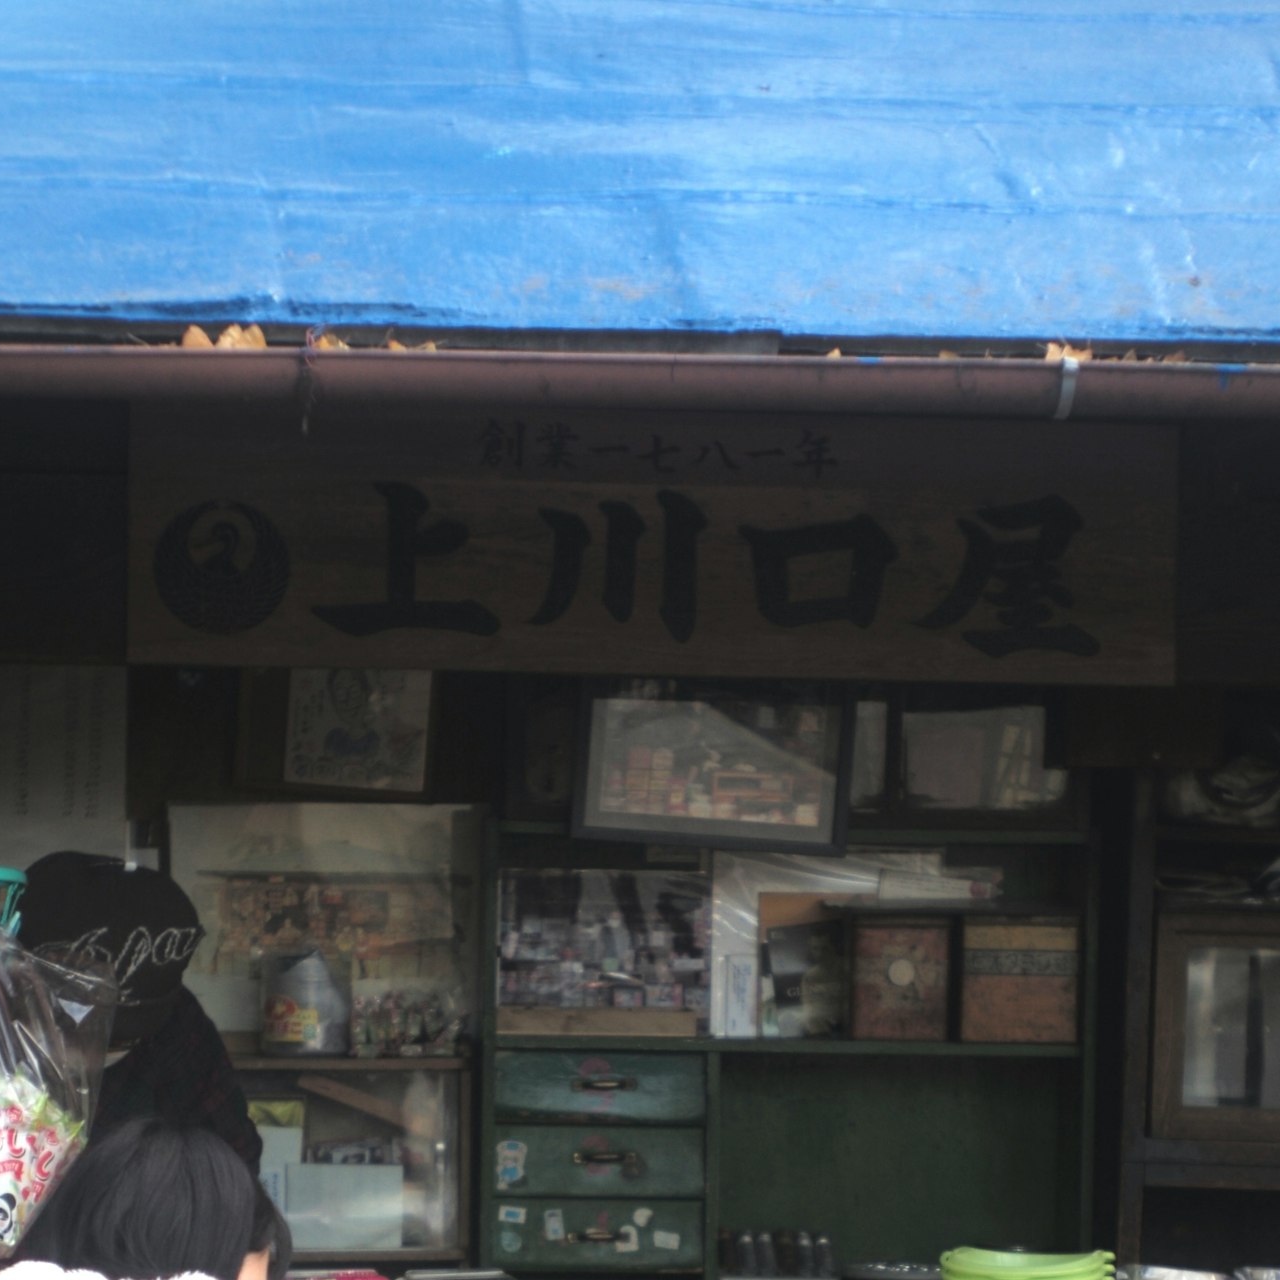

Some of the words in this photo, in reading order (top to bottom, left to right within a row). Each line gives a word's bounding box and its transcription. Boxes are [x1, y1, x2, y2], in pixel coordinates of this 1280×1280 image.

[478, 419, 841, 478] 創業一七八一年
[310, 480, 1101, 658] 上川口屋
